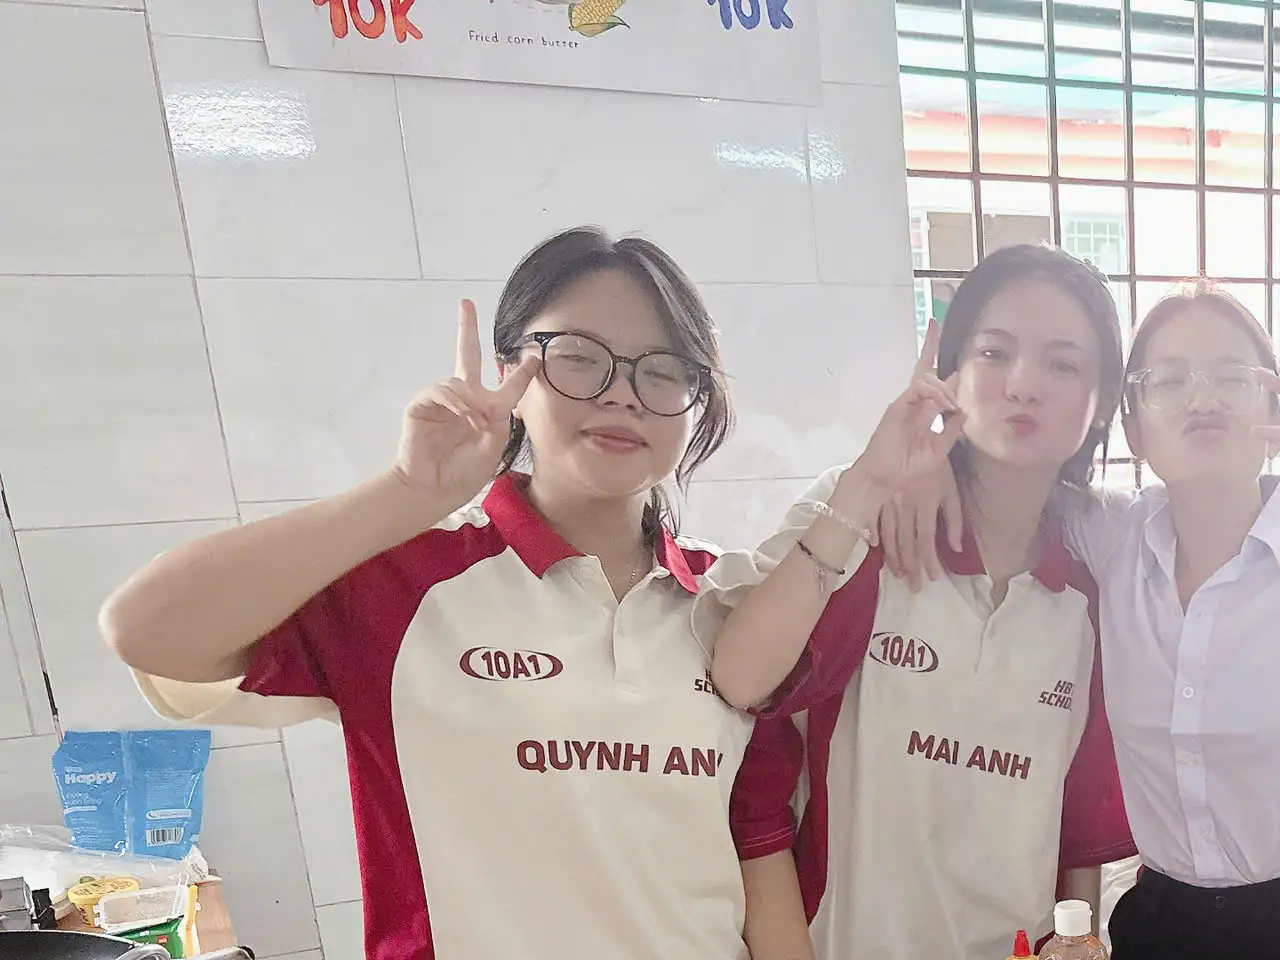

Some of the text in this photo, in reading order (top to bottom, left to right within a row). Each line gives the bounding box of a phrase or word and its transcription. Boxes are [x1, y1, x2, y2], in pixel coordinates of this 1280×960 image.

[468, 30, 579, 48] Fried corn butter
[481, 650, 541, 679] 10A1
[880, 635, 926, 668] 10A1
[516, 739, 723, 777] QUYNH AN
[907, 730, 1032, 780] MAI ANH
